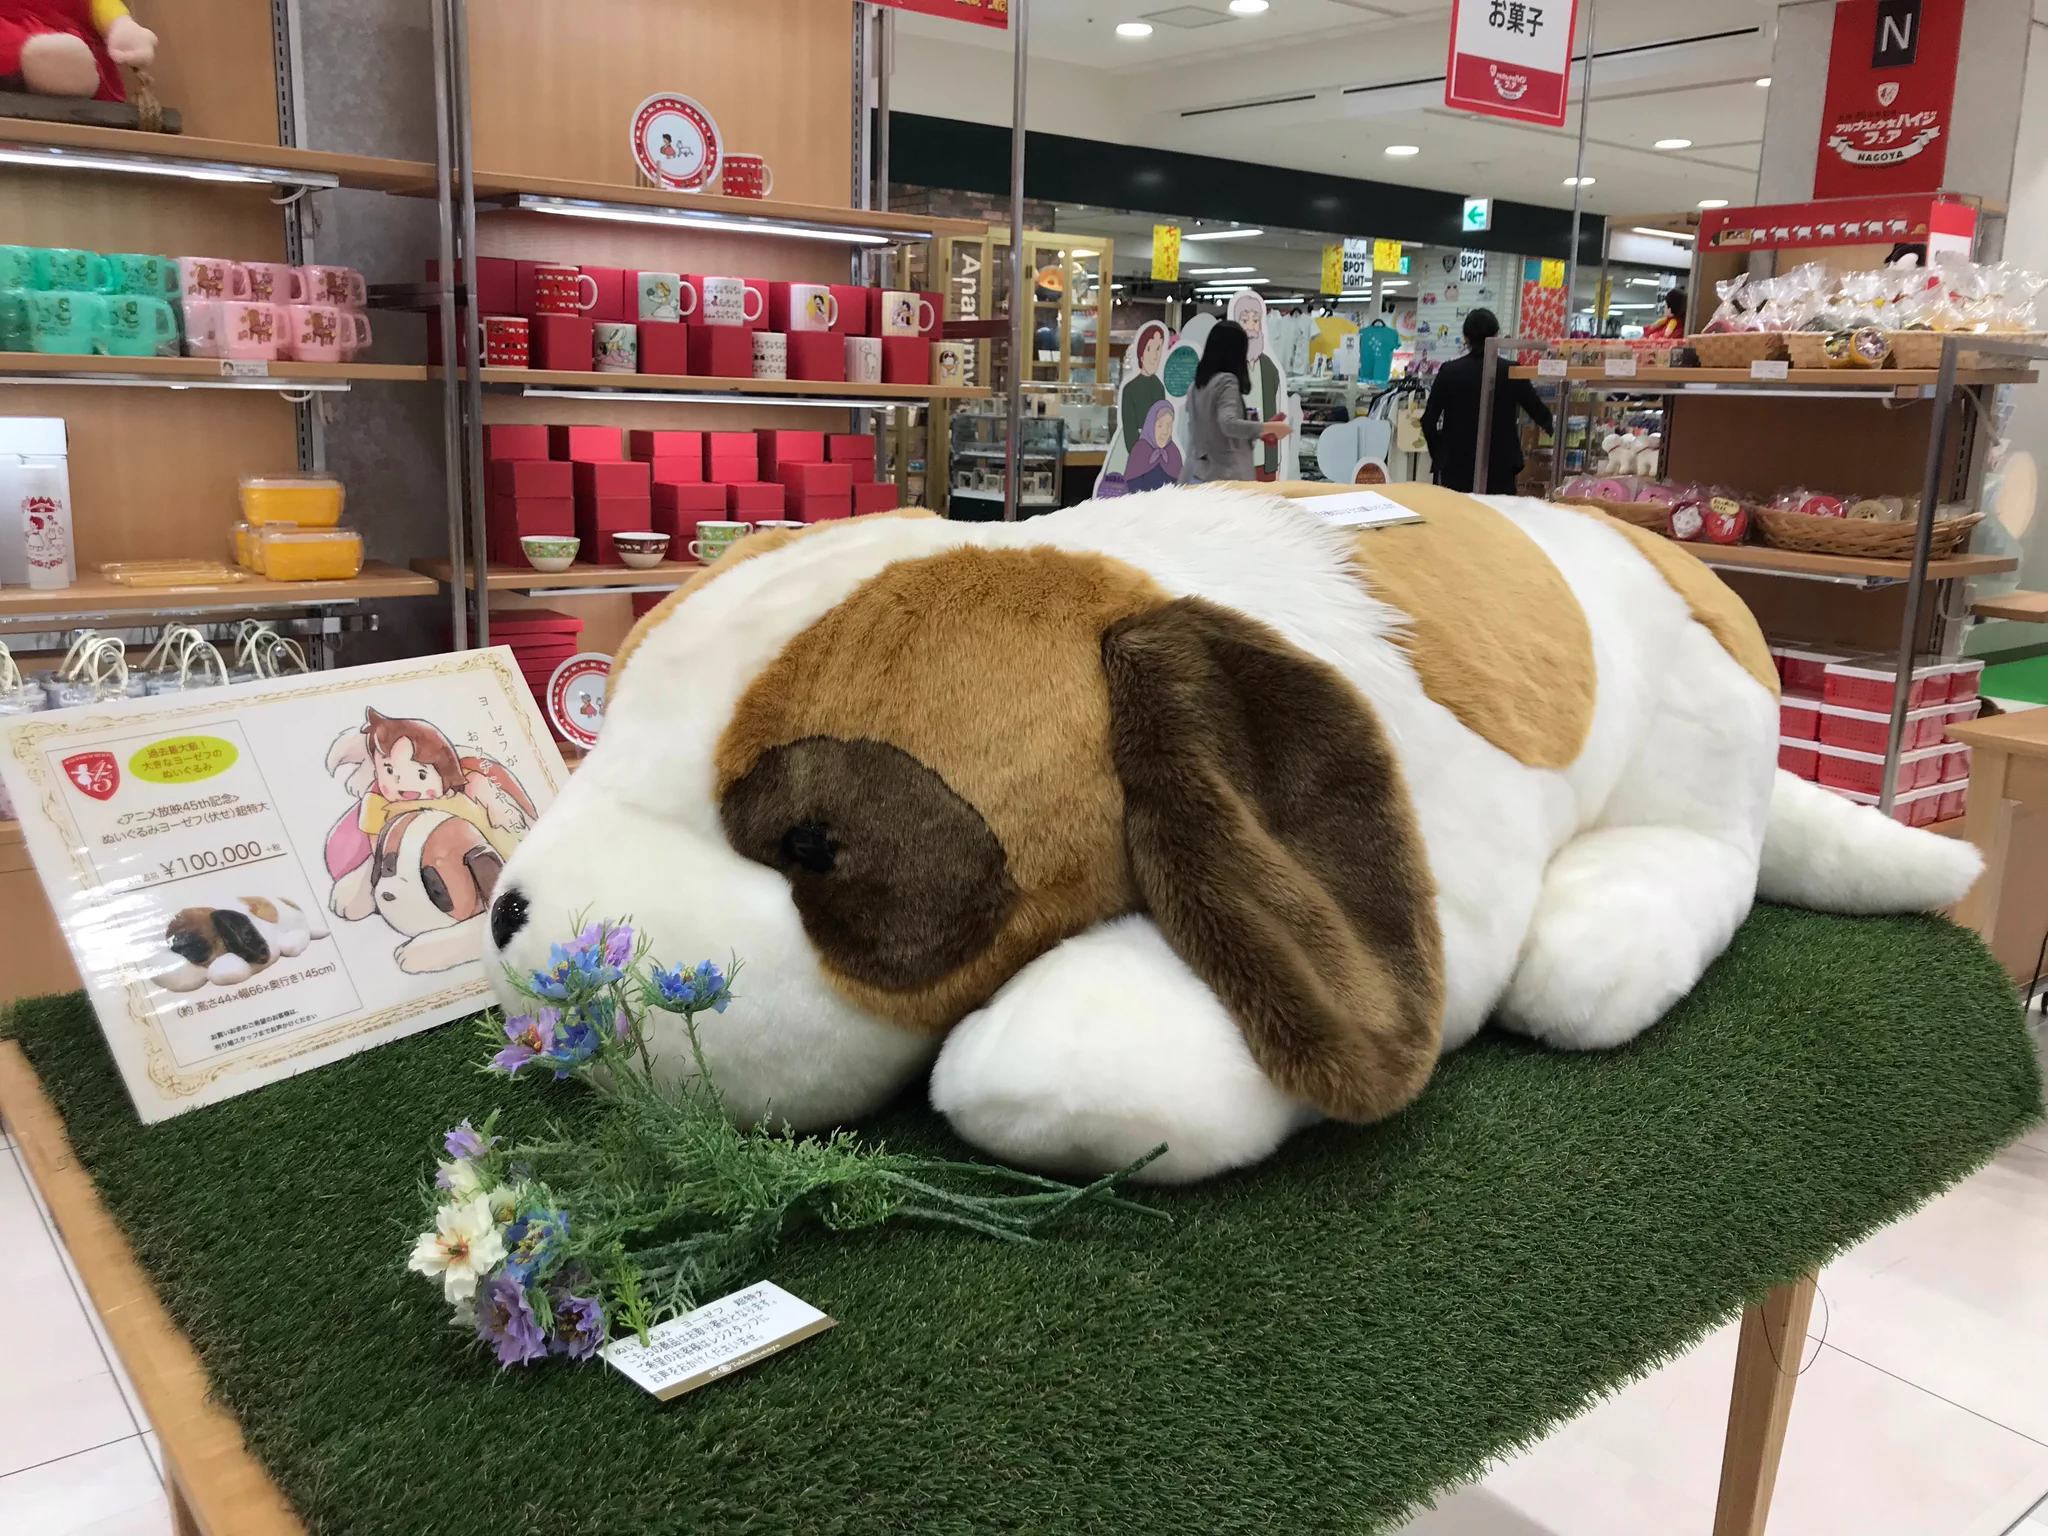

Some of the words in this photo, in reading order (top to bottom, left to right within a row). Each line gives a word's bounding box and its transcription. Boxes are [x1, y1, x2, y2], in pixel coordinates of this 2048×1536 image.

[1488, 0, 1543, 37] お菓子
[1880, 12, 1913, 52] N
[1863, 128, 1902, 146] フェア
[1857, 150, 1904, 162] NAGOYA
[1342, 274, 1365, 288] LIGHT
[1460, 269, 1483, 283] LIGHT
[478, 695, 519, 768] ヨーゼフが
[142, 749, 223, 771] 大きなヨーゼフの
[162, 762, 214, 780] ぬいぐるみ
[159, 840, 262, 878] ¥100,000
[614, 1328, 673, 1357] ぬいるみ
[730, 1342, 782, 1369] Takashimaya
